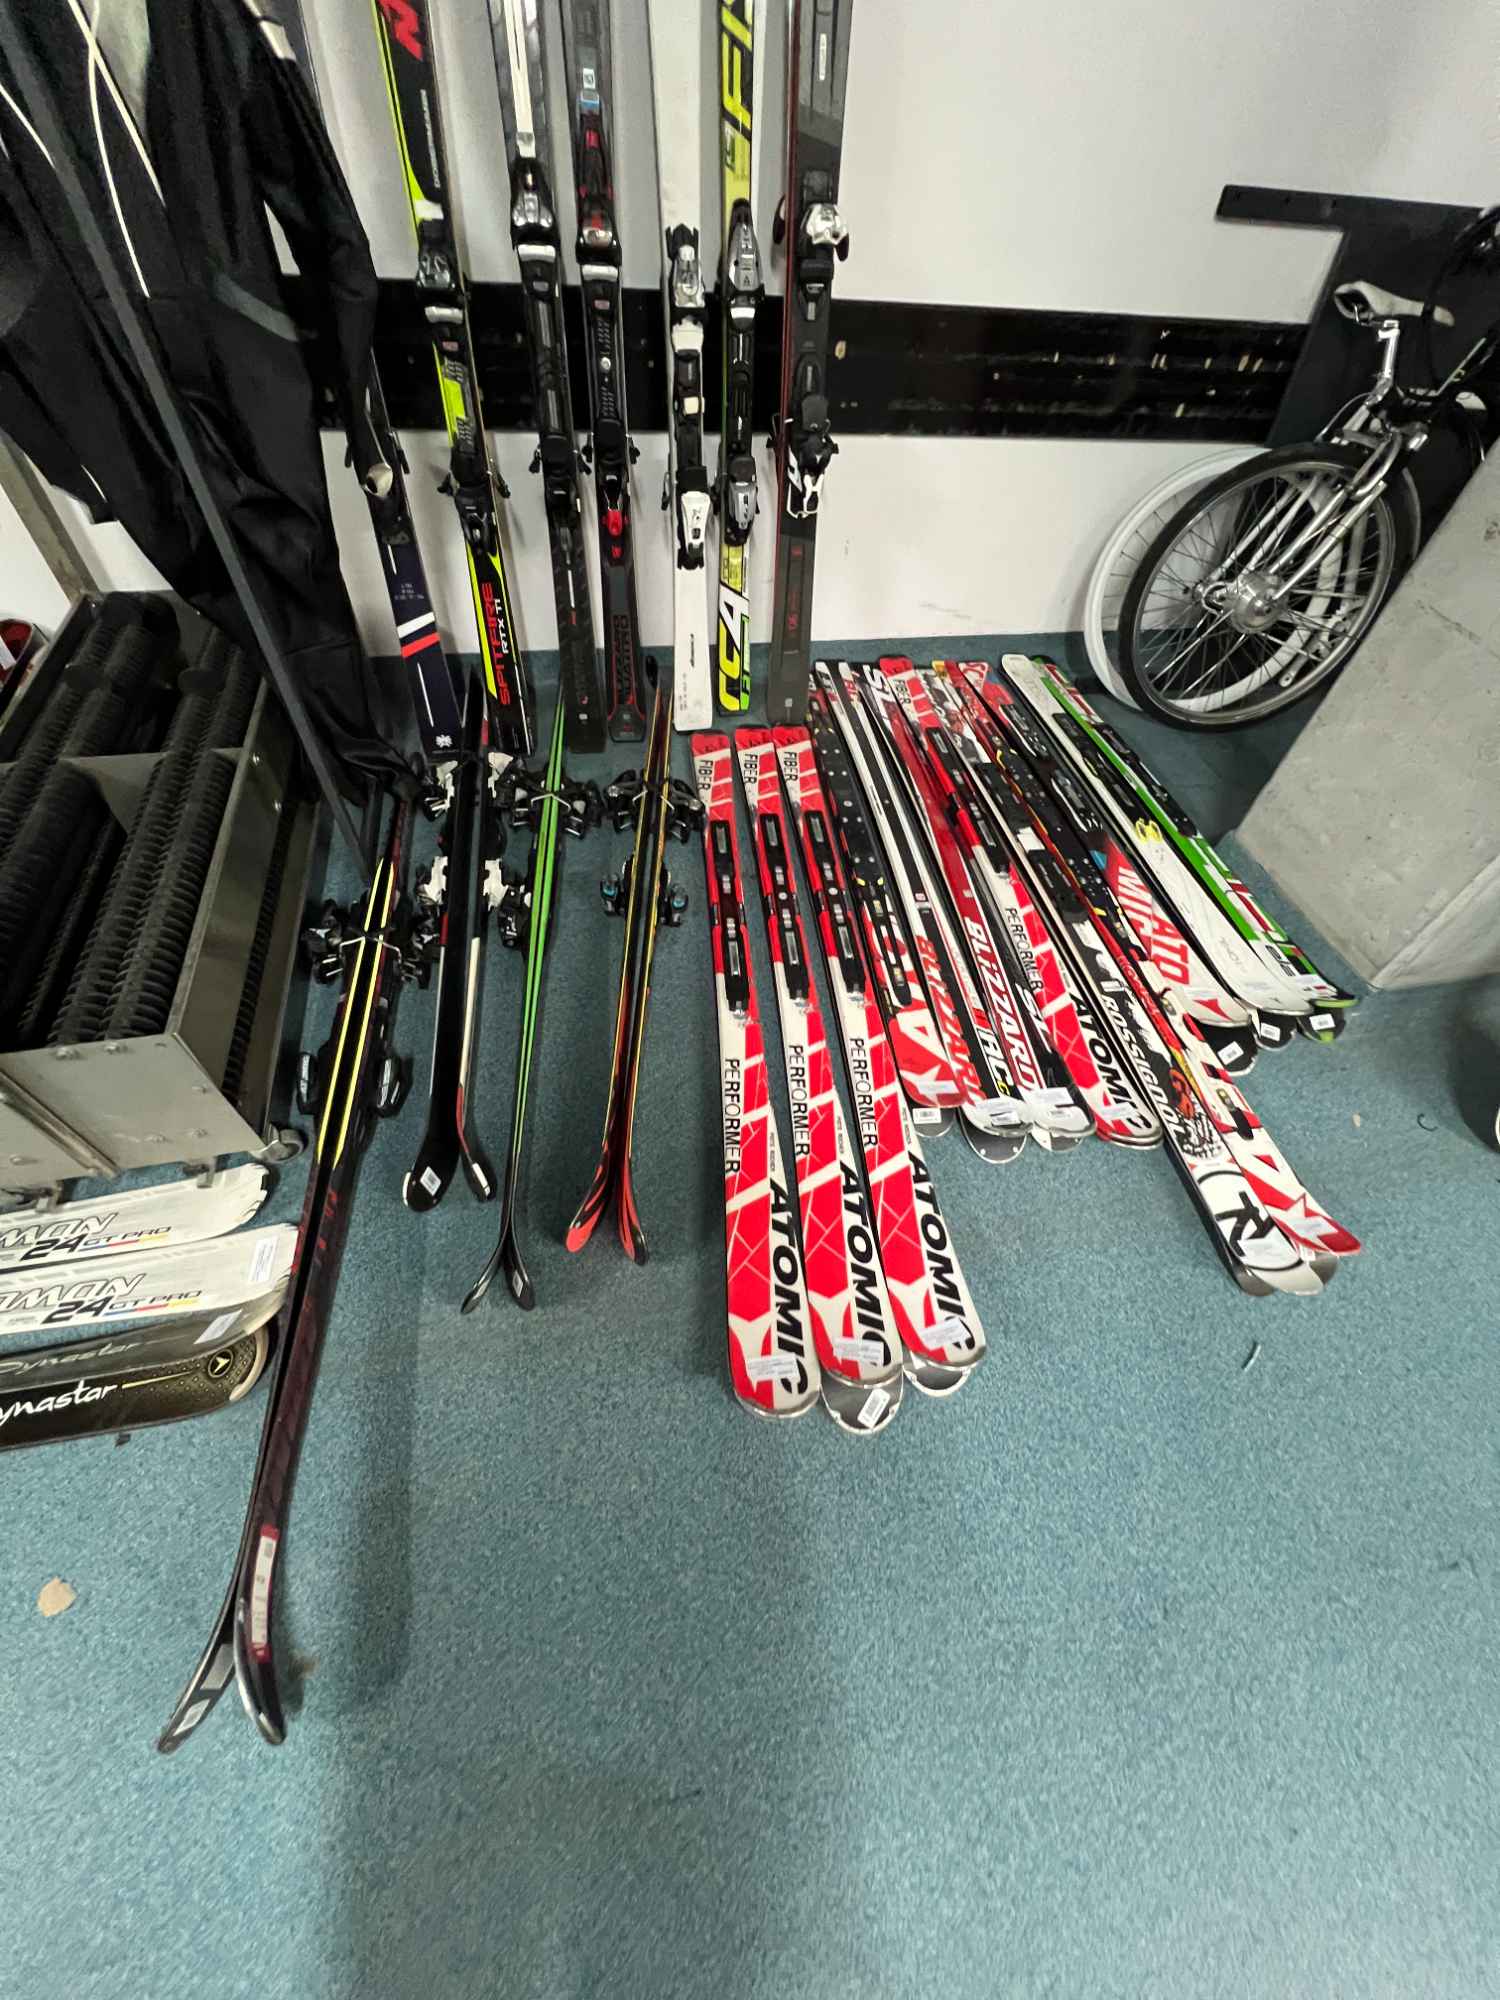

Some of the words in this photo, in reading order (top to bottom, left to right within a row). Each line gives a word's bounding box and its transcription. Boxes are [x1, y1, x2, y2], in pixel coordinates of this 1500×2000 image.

[481, 582, 511, 705] SPITFIRE
[499, 618, 510, 654] RTX
[696, 759, 711, 791] FIBER
[743, 753, 757, 785] FIBER
[783, 751, 798, 782] FIBER
[1005, 907, 1044, 992] PERFORMER
[849, 1037, 878, 1147] PERFORMER
[1103, 995, 1186, 1134] ROSSIGNOL
[724, 1058, 741, 1174] PERFORMER
[788, 1045, 810, 1156] PERFORMER
[20, 1234, 86, 1261] 24
[122, 1226, 172, 1240] PRO
[41, 1296, 108, 1325] 24
[150, 1289, 202, 1304] PRO
